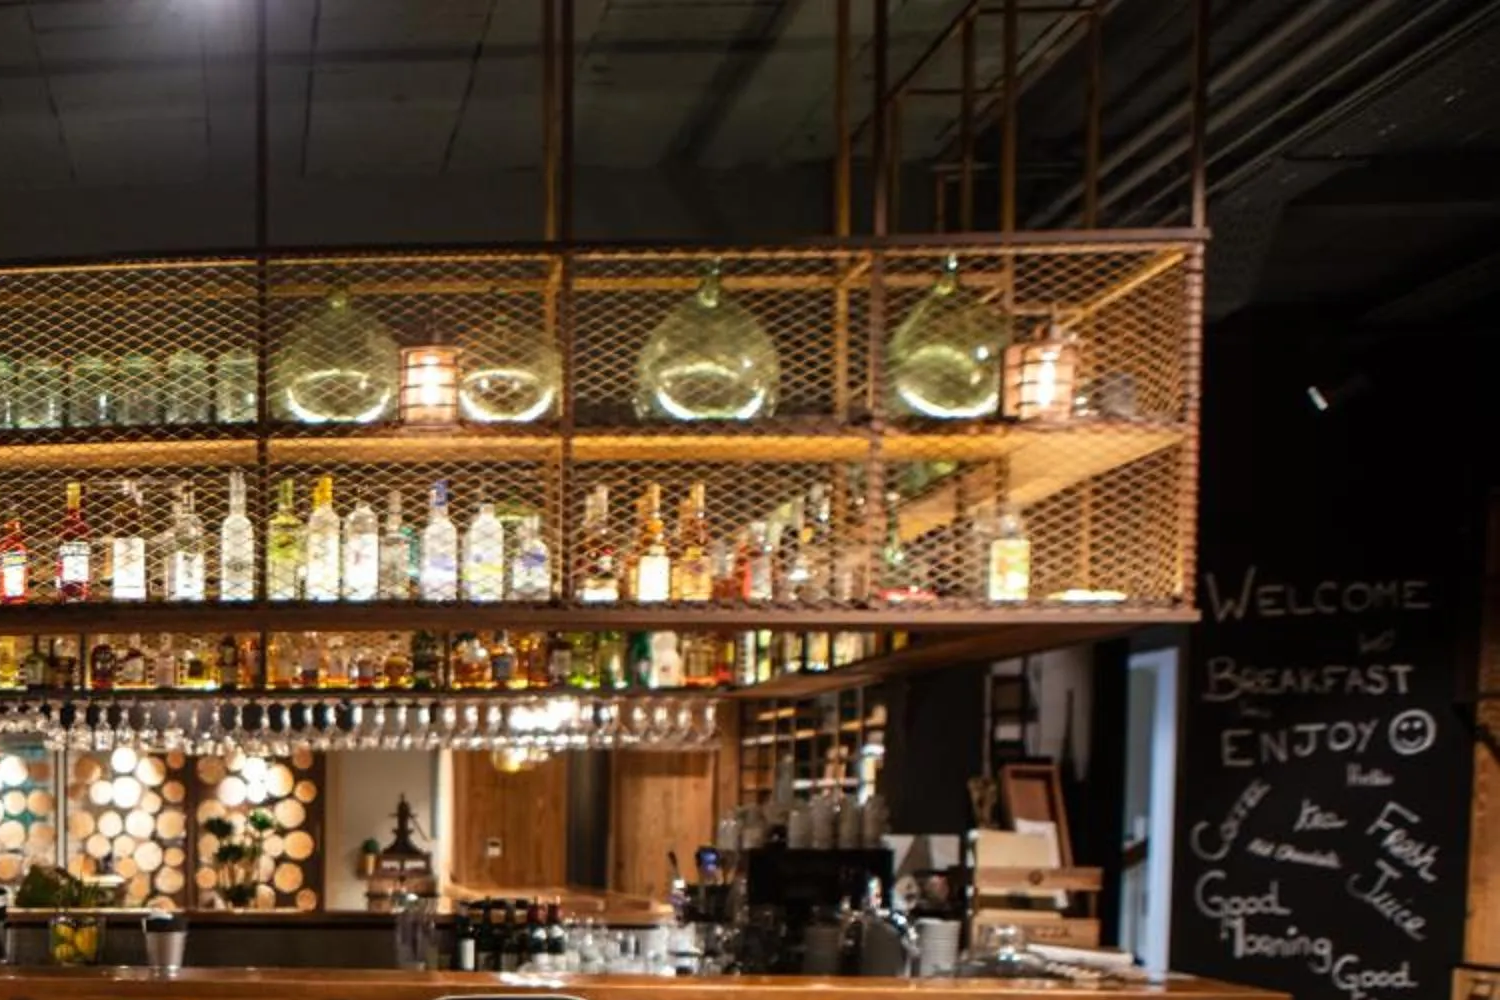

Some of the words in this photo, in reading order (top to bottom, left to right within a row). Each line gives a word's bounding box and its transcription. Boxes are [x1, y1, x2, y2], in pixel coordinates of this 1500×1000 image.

[1205, 566, 1430, 622] WELCOME
[1201, 656, 1414, 702] BREAKFAST
[1220, 719, 1380, 767] ENJOY
[1194, 869, 1292, 918] Good
[1332, 954, 1418, 990] Good
